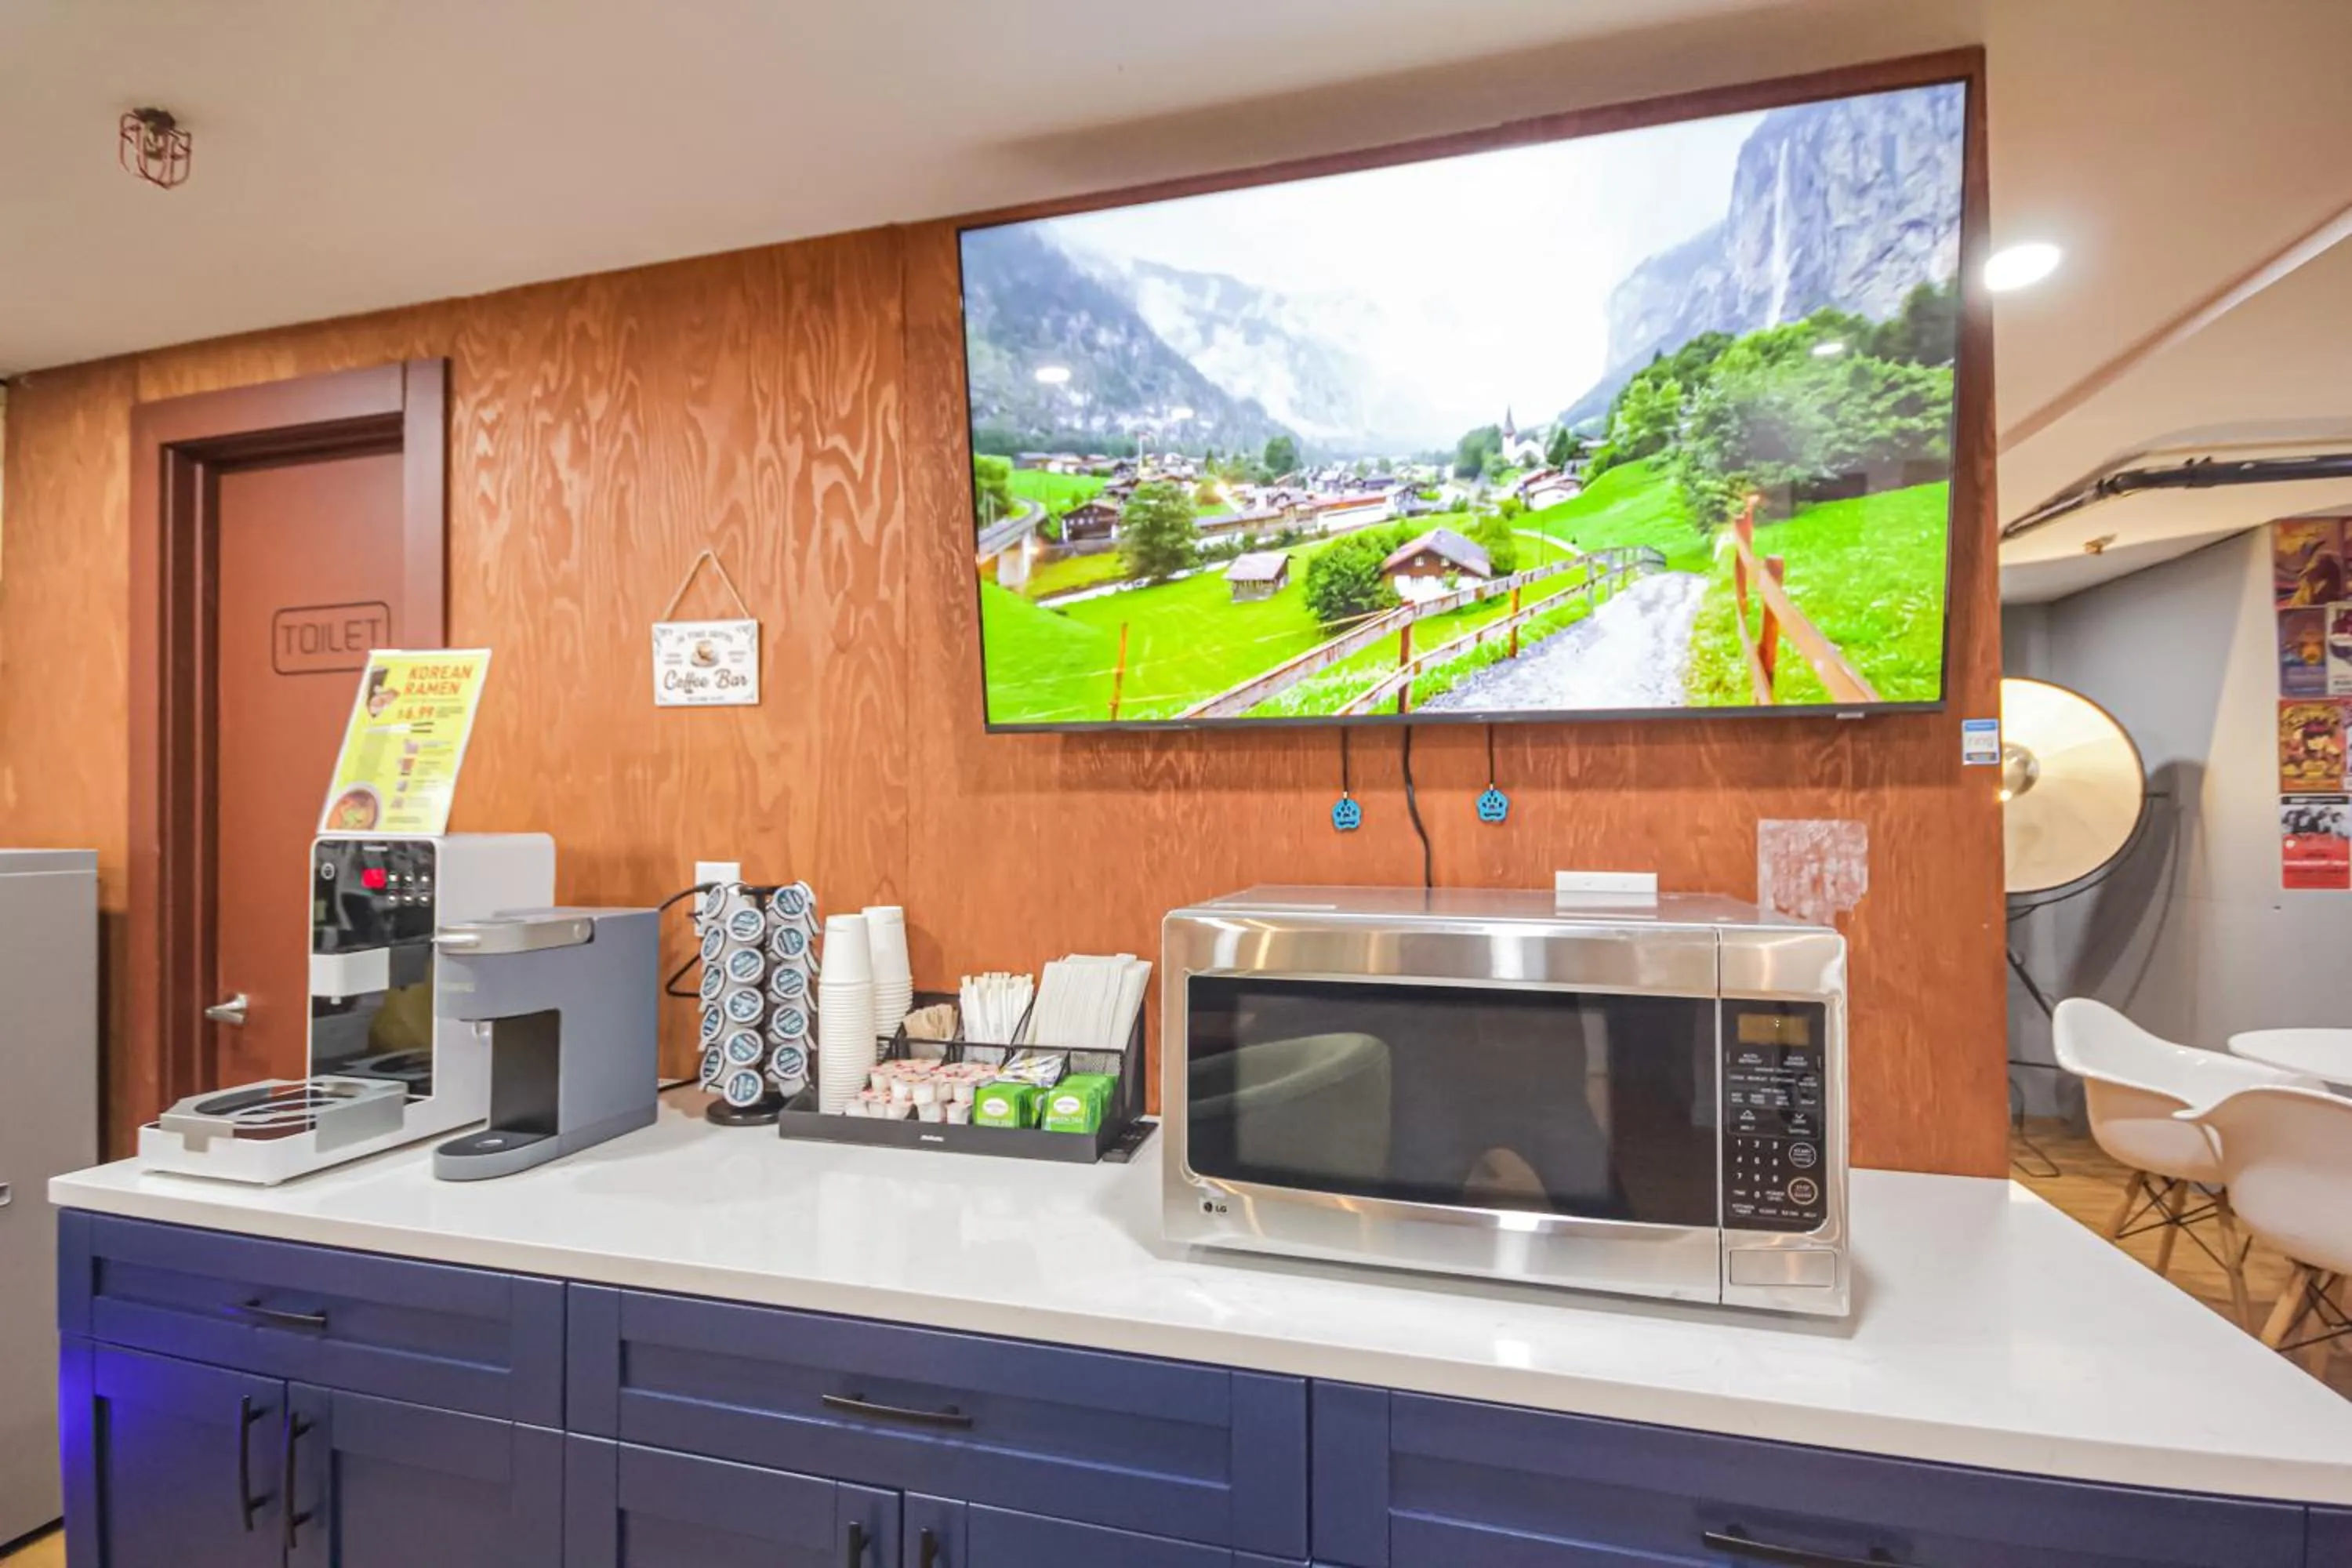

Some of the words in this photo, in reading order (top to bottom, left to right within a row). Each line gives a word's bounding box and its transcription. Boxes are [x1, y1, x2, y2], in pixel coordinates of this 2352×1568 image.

[280, 618, 382, 656] TOILET
[408, 664, 474, 680] KOREAN
[403, 681, 462, 696] RAMEN
[664, 669, 710, 695] Coffee
[714, 667, 749, 690] Bar
[1216, 1204, 1227, 1213] LG
